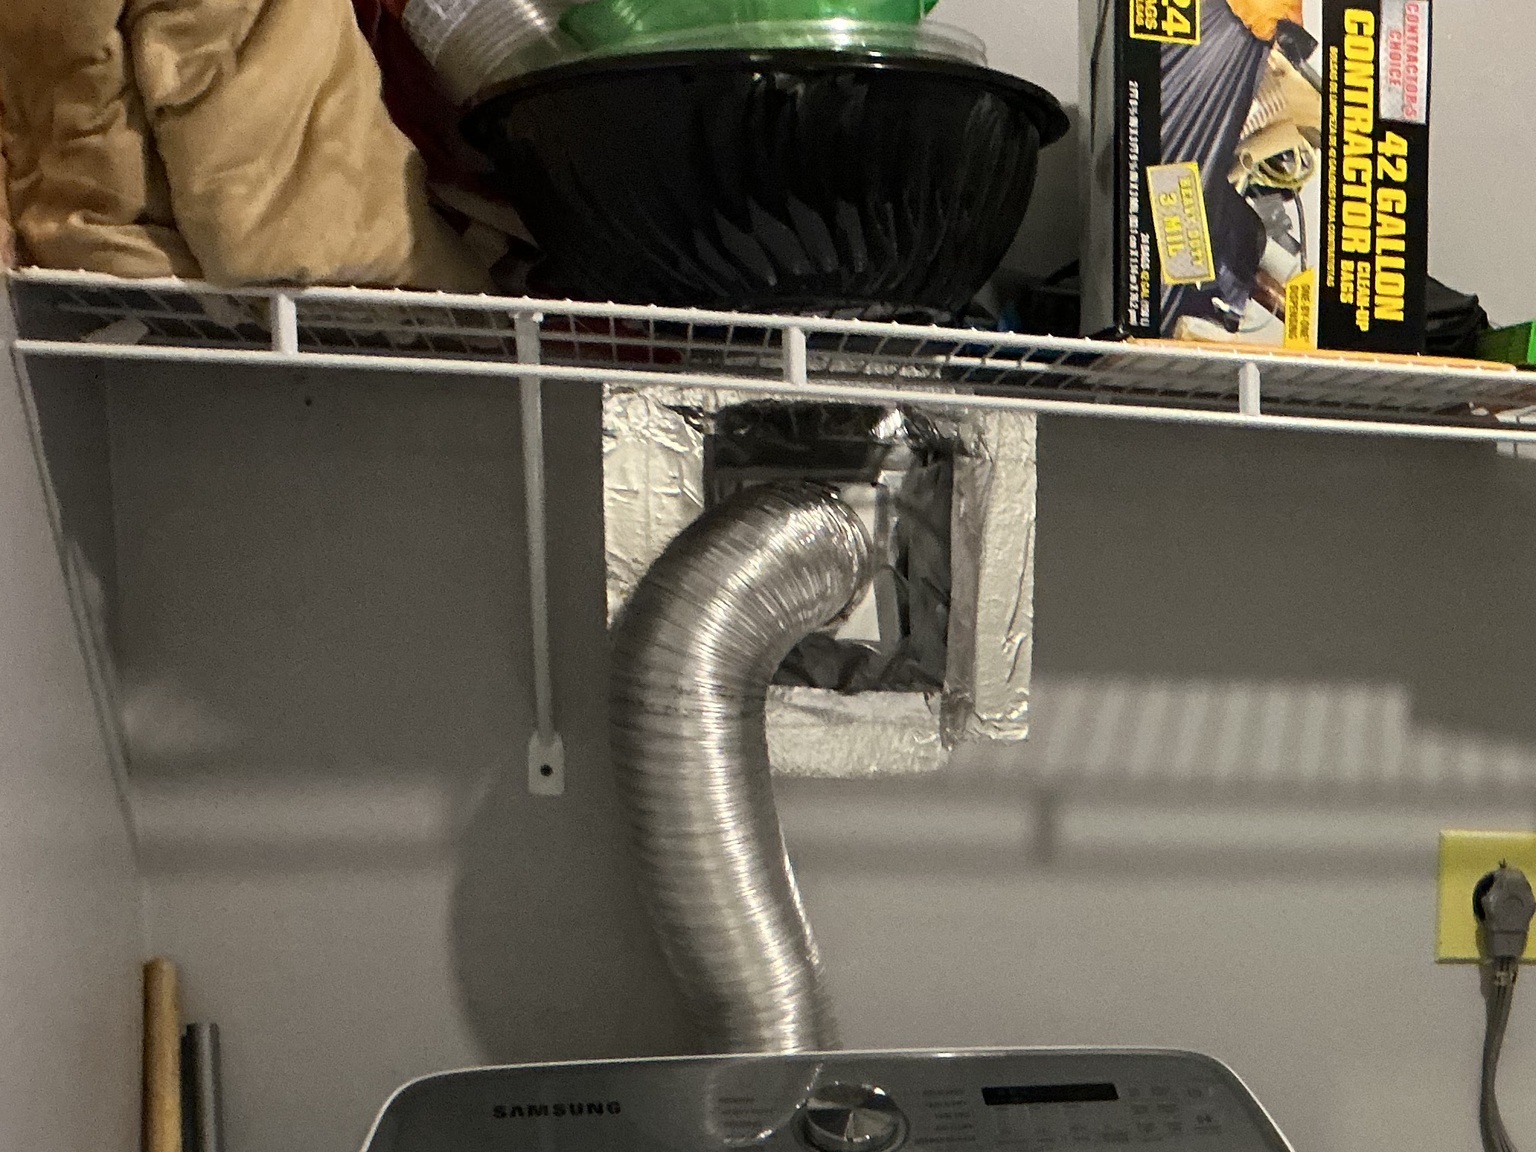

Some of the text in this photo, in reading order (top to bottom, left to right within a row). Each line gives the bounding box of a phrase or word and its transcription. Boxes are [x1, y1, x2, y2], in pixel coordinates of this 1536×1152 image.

[1388, 29, 1402, 87] CHOICE
[1341, 7, 1375, 254] CONTRACTOR
[1160, 192, 1184, 257] 3 MIL
[1179, 176, 1203, 265] HEAVY DUTY
[1374, 131, 1408, 321] 42 GALLON
[1339, 259, 1355, 305] BAGS
[1355, 260, 1371, 332] CLEAN-UP
[492, 1100, 621, 1119] SAMSUNG
